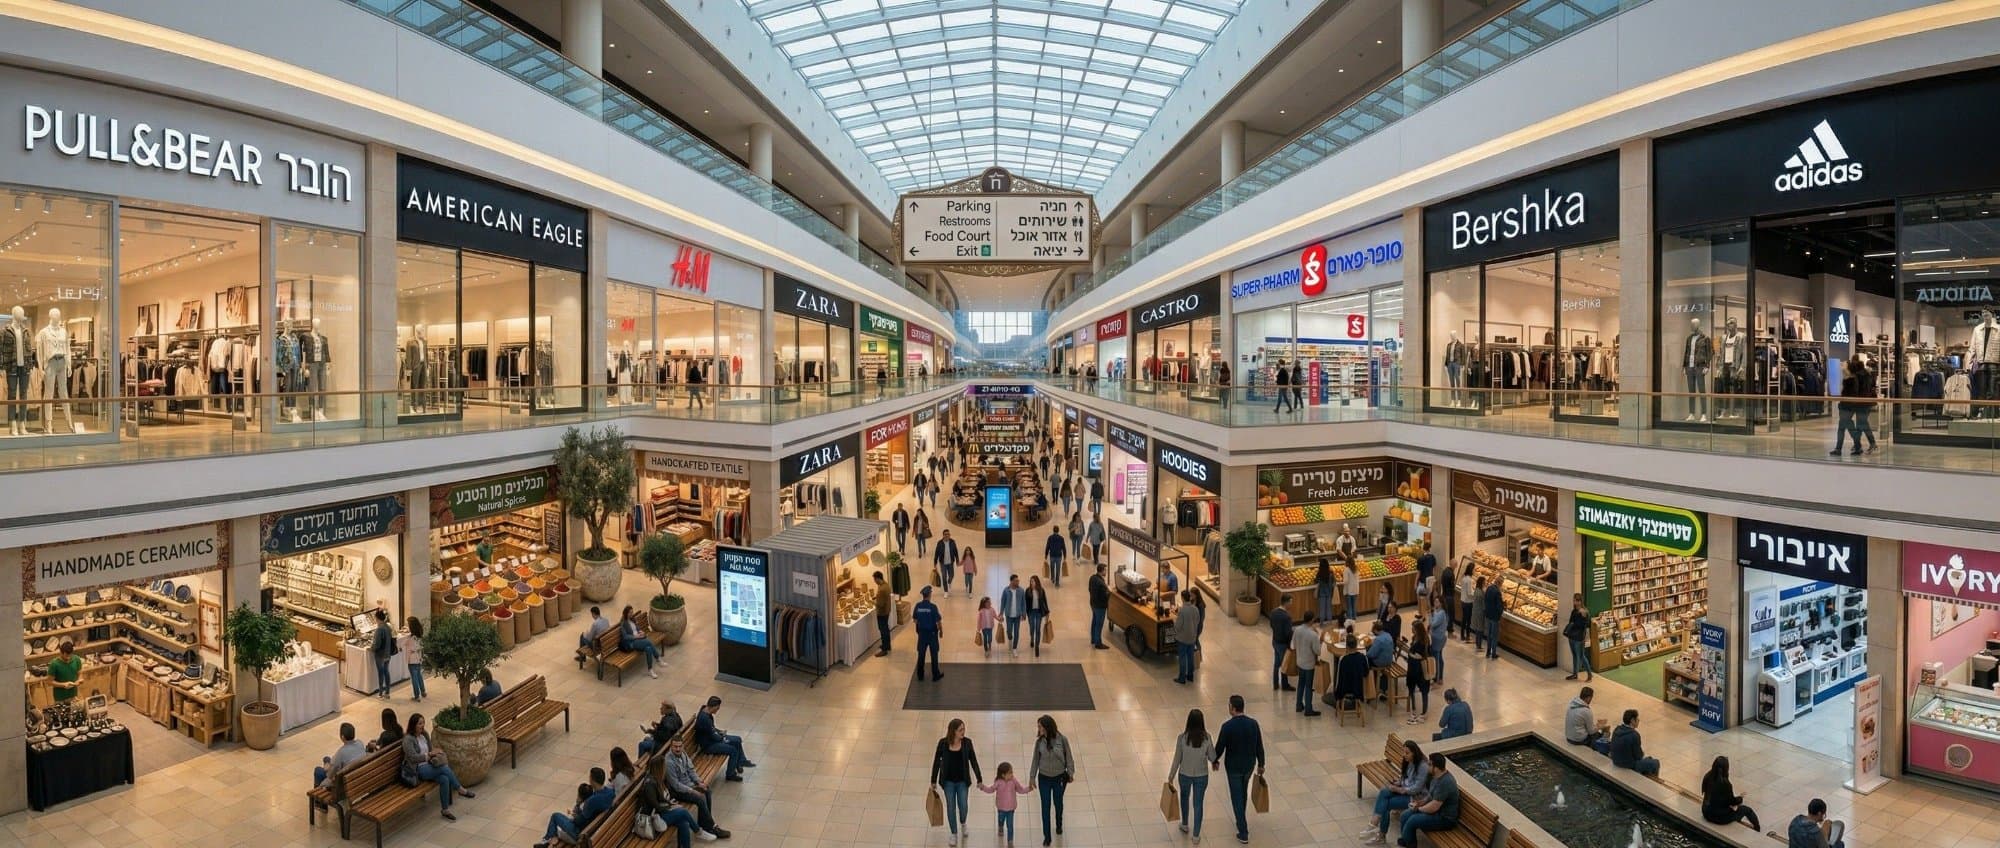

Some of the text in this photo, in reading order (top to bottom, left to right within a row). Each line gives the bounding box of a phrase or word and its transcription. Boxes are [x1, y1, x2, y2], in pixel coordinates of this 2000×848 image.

[25, 104, 262, 185] PULL&BEAR
[1775, 162, 1863, 191] adidas
[407, 187, 582, 248] AMERICAN EAGLE
[947, 200, 991, 213] Parking
[1040, 202, 1067, 212] חניה
[1452, 188, 1584, 250] Bershka
[939, 216, 991, 226] Restrooms
[1018, 216, 1067, 227] שירותים
[924, 230, 991, 242] Food Court
[1010, 229, 1067, 241] אזור אוכל
[956, 245, 978, 257] Exit
[1033, 246, 1067, 257] יציאה
[1326, 240, 1404, 277] סופר-פארם
[671, 243, 711, 294] H&M
[1231, 267, 1301, 298] SUPER-PHARM
[796, 288, 839, 318] ZARA
[1141, 294, 1199, 324] CASTRO
[1562, 298, 1601, 312] Bershka
[799, 443, 842, 475] ZARA
[1161, 449, 1207, 481] HOODIES
[1292, 467, 1383, 487] מיצים טריים
[456, 487, 487, 505] הטבע
[478, 495, 527, 513] Natural Spices
[490, 484, 502, 499] מן
[1338, 485, 1369, 497] Juices
[1495, 487, 1548, 514] מאפייה
[1578, 505, 1636, 531] STIMATZKY
[1637, 517, 1693, 542] סטימצקי
[295, 520, 378, 548] LOCAL JEWELRY
[41, 538, 214, 579] HANDMADE CERAMICS
[1750, 531, 1850, 574] אייבורי
